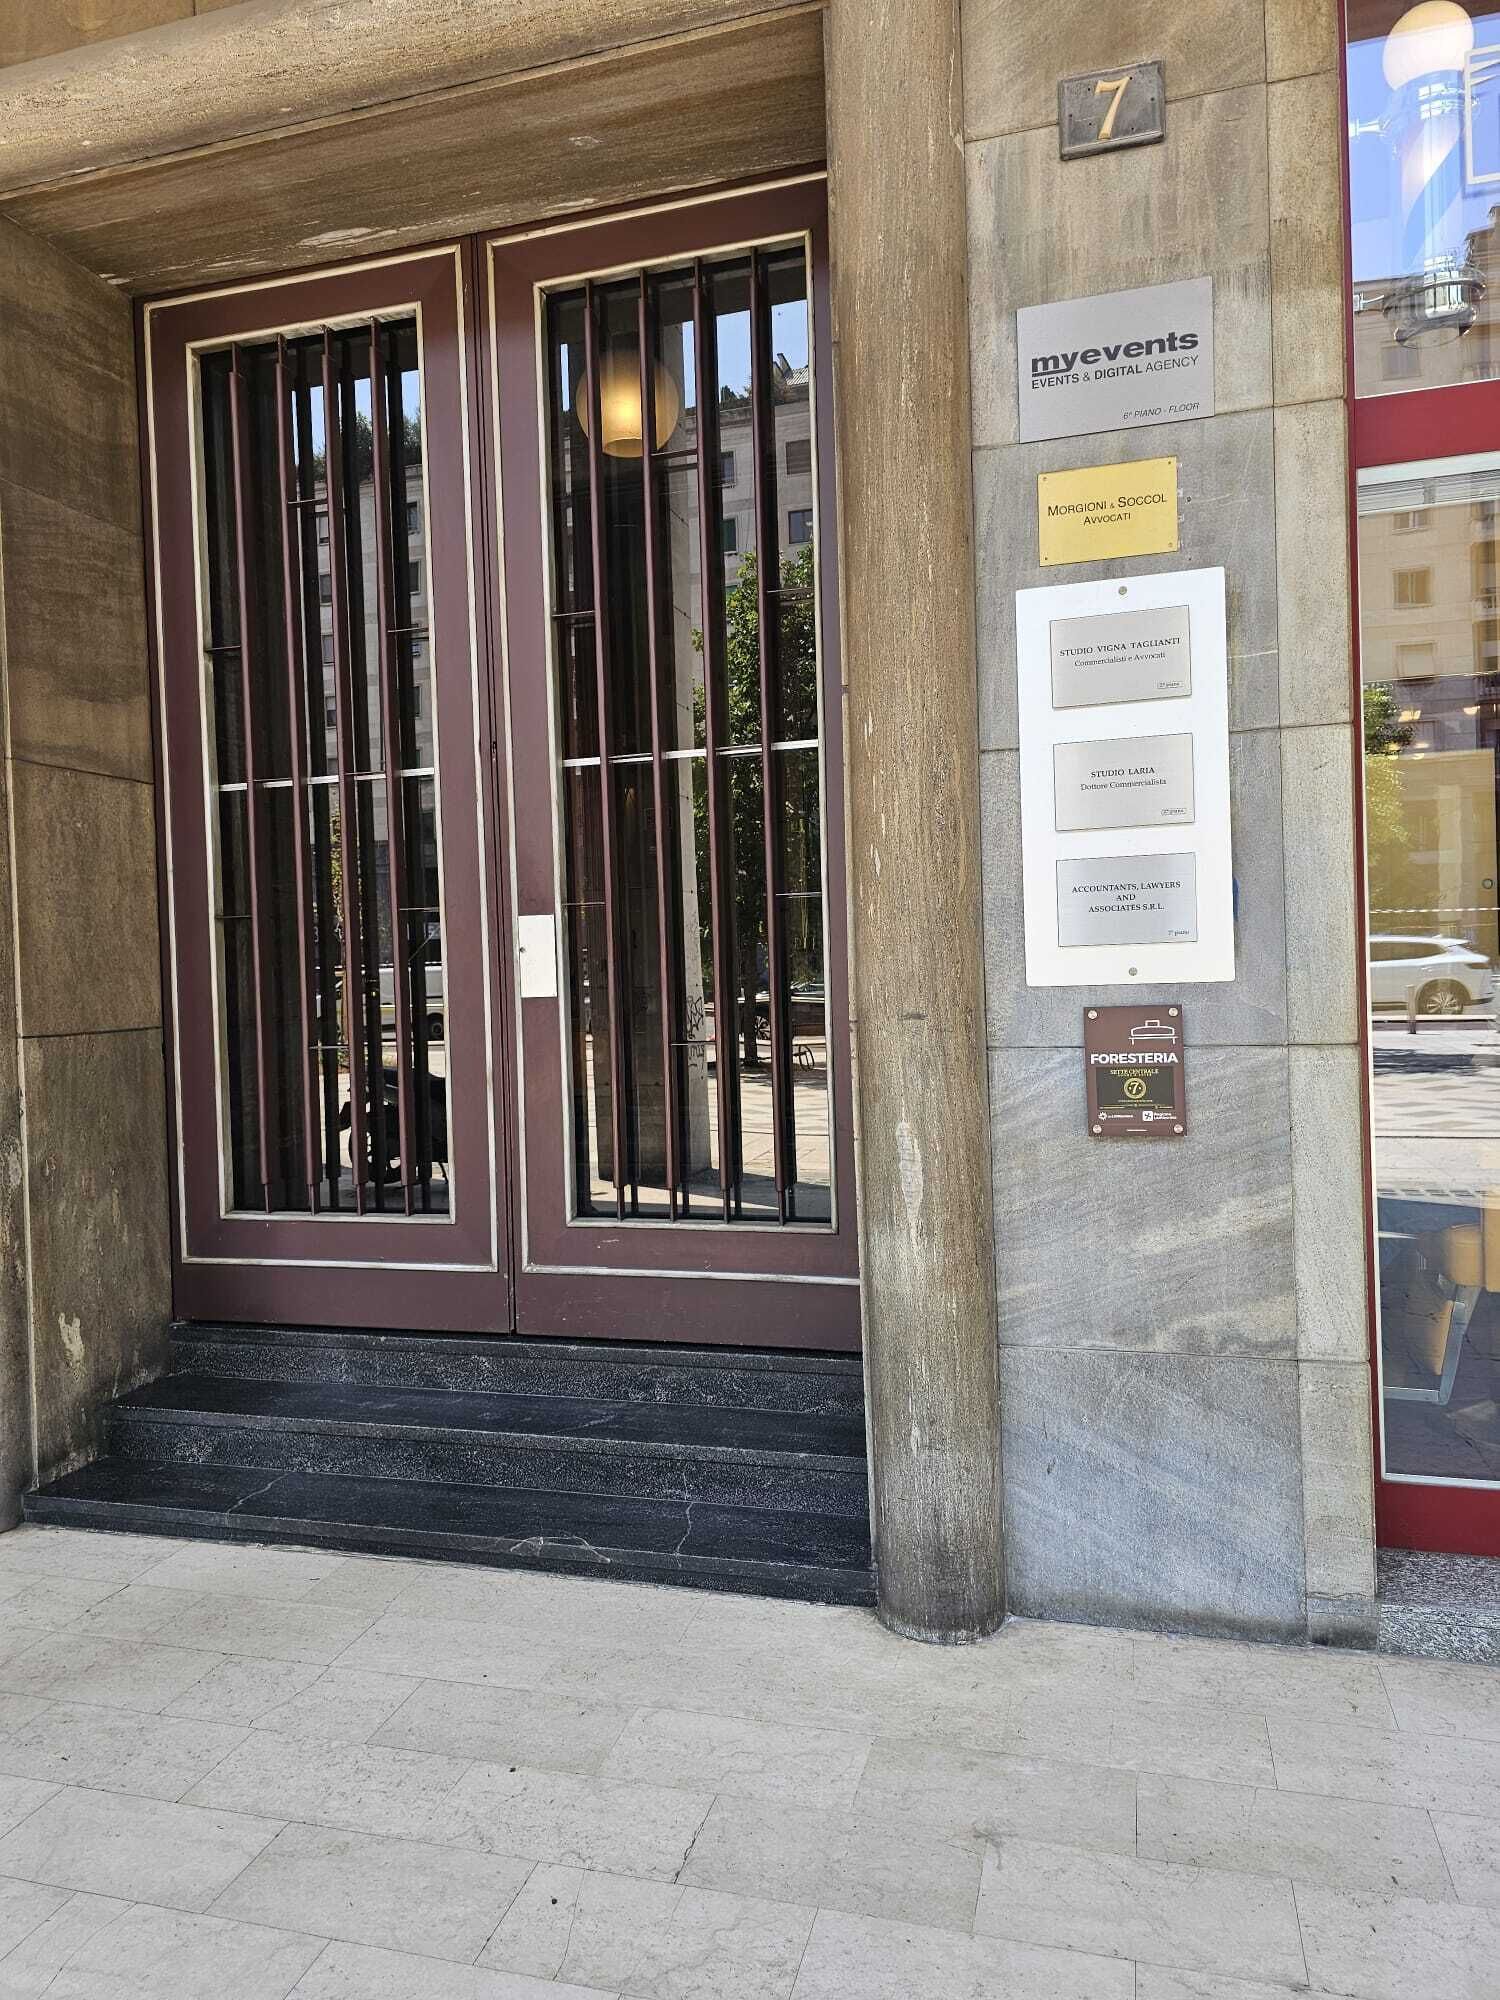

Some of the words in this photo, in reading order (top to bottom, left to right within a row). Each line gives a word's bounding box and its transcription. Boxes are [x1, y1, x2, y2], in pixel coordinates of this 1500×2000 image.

[1095, 76, 1130, 140] 7
[1031, 332, 1199, 377] myevents
[1032, 373, 1080, 389] EVENTS
[1083, 371, 1090, 382] &
[1094, 363, 1142, 380] DIGITAL
[1145, 355, 1199, 373] AGENCY
[1134, 407, 1162, 417] PIANO
[1168, 402, 1200, 413] FLOOR
[1047, 500, 1107, 517] MORGIONI
[1118, 493, 1167, 508] SOCCOL
[1083, 512, 1131, 526] AVVOCATI
[1060, 647, 1093, 657] STUDIO
[1097, 643, 1127, 653] VIGNA
[1130, 637, 1180, 649] TAGLIANTI
[1090, 769, 1125, 778] STUDIO
[1128, 767, 1156, 775] LARIA
[1109, 778, 1167, 789] Commercialista
[1072, 883, 1139, 893] ACCOUNTANTS,
[1141, 881, 1181, 890] LAWYERS
[1088, 904, 1141, 913] ASSOCIATES
[1142, 903, 1165, 911] S.R.L.
[1090, 1052, 1179, 1065] FORESTERIA
